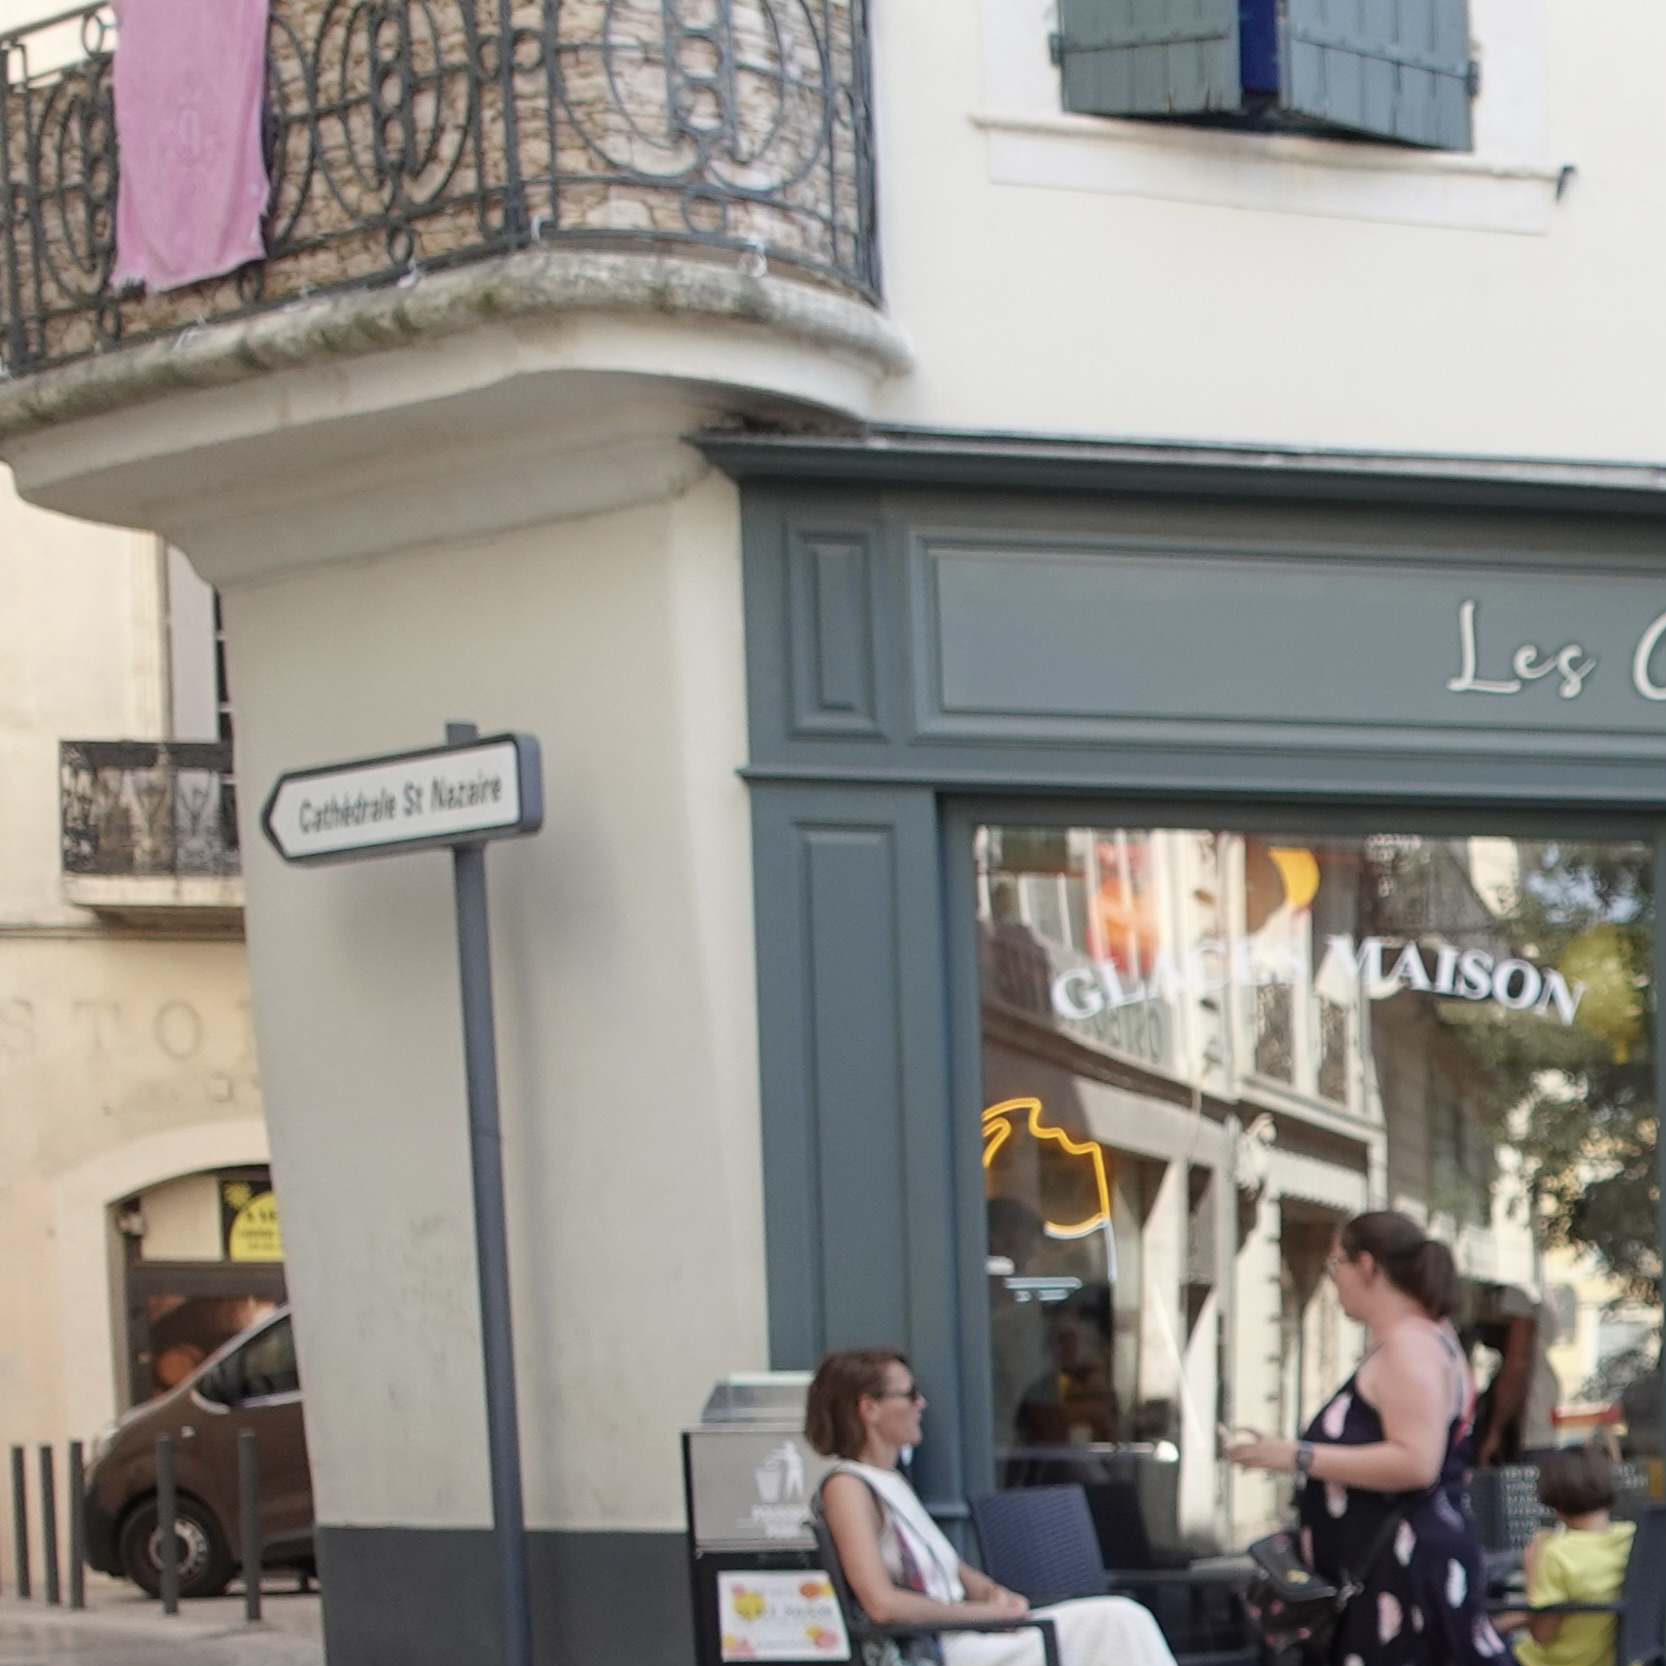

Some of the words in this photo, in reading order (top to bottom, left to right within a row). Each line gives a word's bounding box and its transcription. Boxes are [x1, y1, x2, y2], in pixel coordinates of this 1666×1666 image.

[1447, 599, 1597, 700] Les
[299, 785, 396, 834] Cathédrale
[403, 781, 424, 817] St
[431, 770, 502, 814] Nazaire
[1051, 940, 1306, 1021] GLACES
[1326, 934, 1588, 1027] MAISON
